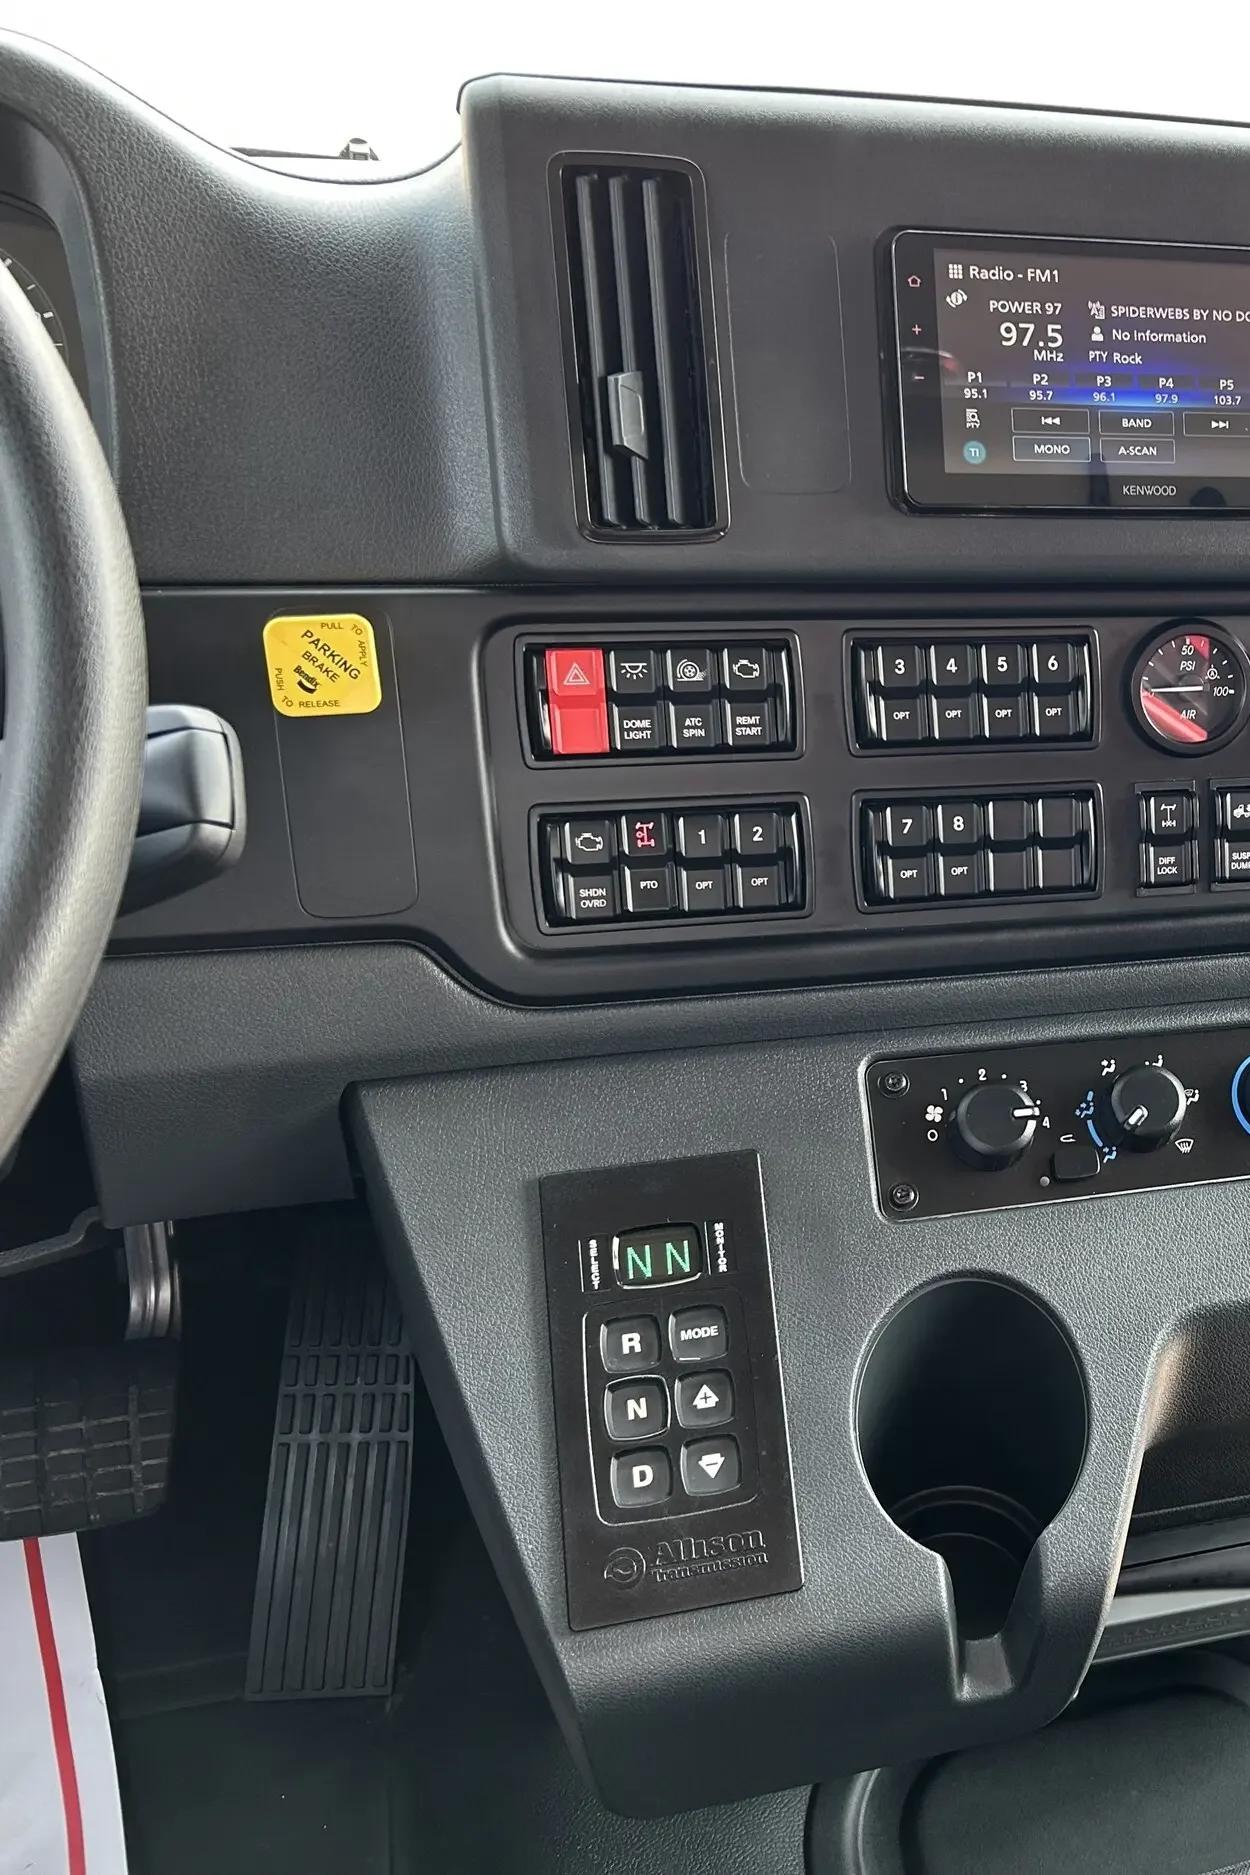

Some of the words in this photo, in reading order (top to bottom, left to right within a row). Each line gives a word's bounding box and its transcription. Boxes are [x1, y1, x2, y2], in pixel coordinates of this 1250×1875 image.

[969, 265, 1014, 281] Radio
[1027, 268, 1060, 283] FM1
[989, 300, 1043, 315] POWER
[1044, 303, 1063, 316] 97
[1111, 305, 1190, 321] SPIDERWEBS
[1193, 309, 1210, 321] BY
[1213, 310, 1233, 322] NO
[1000, 321, 1063, 348] 97.5
[1112, 329, 1131, 341] No
[1134, 330, 1207, 344] Information
[1033, 350, 1064, 362] MHz
[1088, 351, 1108, 363] PTY
[1113, 352, 1143, 365] Rock
[967, 372, 983, 383] P1
[1033, 373, 1049, 385] P2
[1096, 376, 1112, 387] P3
[1158, 378, 1174, 389] P4
[1219, 379, 1234, 391] P5
[963, 388, 988, 399] 95.1
[1029, 390, 1053, 401] 95.7
[1093, 392, 1116, 402] 96.1
[1155, 393, 1179, 404] 97.9
[1213, 395, 1242, 406] 103.7
[1122, 418, 1152, 428] BAND
[1034, 444, 1070, 455] MONO
[1118, 447, 1157, 456] A-SCAN
[1122, 485, 1177, 496] KENWOOD
[320, 622, 344, 630] PULL
[351, 624, 363, 636] TO
[358, 640, 368, 667] APPLY
[301, 629, 361, 680] PARKING
[1181, 645, 1194, 656] 50
[302, 651, 340, 683] BRAKE
[894, 659, 906, 675] 3
[946, 658, 958, 673] 4
[997, 656, 1008, 672] 5
[1048, 655, 1059, 671] 6
[1180, 661, 1196, 671] PSI
[293, 665, 321, 688] Bendix
[275, 667, 285, 691] PUSH
[281, 696, 293, 708] TO
[298, 700, 341, 708] RELEASE
[1213, 687, 1229, 697] 100
[893, 711, 911, 720] OPT
[945, 710, 962, 719] OPT
[995, 709, 1013, 718] OPT
[1045, 707, 1063, 717] OPT
[1180, 709, 1197, 720] AIR
[623, 719, 651, 728] DOME
[685, 717, 703, 727] ATC
[736, 716, 760, 725] REMT
[624, 730, 651, 740] LIGHT
[683, 728, 705, 738] SPIN
[735, 726, 762, 736] START
[901, 819, 913, 834] 7
[953, 816, 965, 831] 8
[698, 829, 706, 845] 1
[752, 826, 763, 842] 2
[1159, 857, 1176, 865] DIFF
[900, 869, 918, 879] OPT
[951, 866, 969, 876] OPT
[1157, 866, 1178, 875] LOCK
[640, 880, 658, 890] PTO
[695, 880, 713, 890] OPT
[751, 877, 768, 886] OPT
[579, 888, 606, 898] SHDN
[581, 899, 607, 908] OVRD
[978, 1068, 987, 1081] 2
[1019, 1080, 1028, 1092] 3
[941, 1088, 948, 1101] 1
[1042, 1116, 1050, 1129] 4
[714, 1222, 728, 1273] MONITOR
[589, 1239, 601, 1291] SELECT
[626, 1244, 653, 1280] N
[665, 1239, 691, 1276] N
[680, 1325, 719, 1341] MODE
[621, 1332, 642, 1356] R
[626, 1397, 648, 1421] N
[632, 1464, 654, 1489] D
[650, 1530, 767, 1566] Allison
[650, 1552, 769, 1583] Transmission
